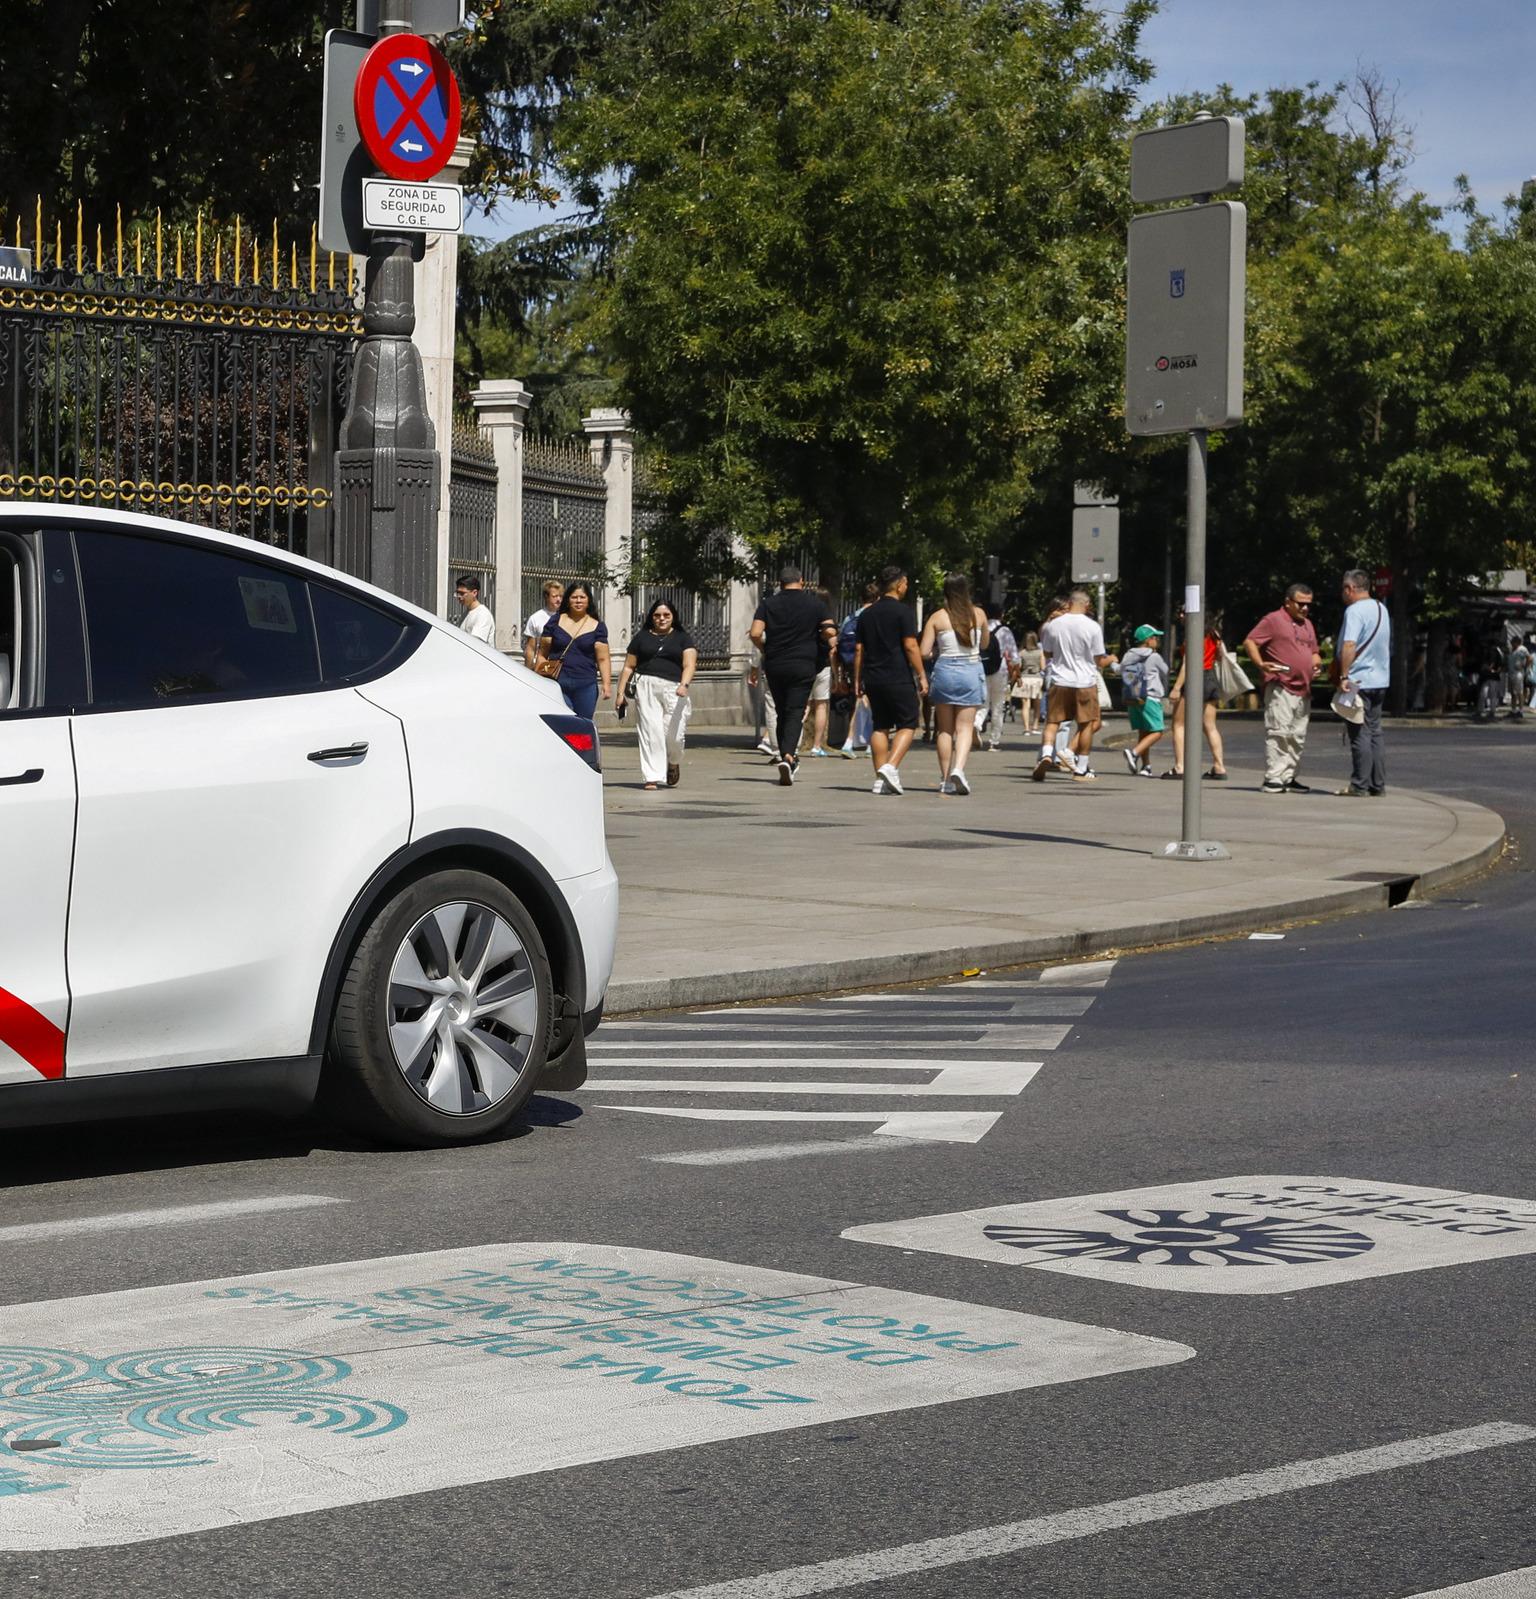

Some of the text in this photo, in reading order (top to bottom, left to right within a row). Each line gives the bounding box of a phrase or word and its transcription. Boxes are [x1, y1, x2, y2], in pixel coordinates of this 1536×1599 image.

[380, 200, 446, 214] SEGURIDAD
[388, 188, 438, 201] ZONA DE
[397, 215, 430, 226] C.G.E.
[1170, 359, 1197, 370] MOSA
[1211, 1192, 1527, 1236] Distrito
[373, 1287, 798, 1372] EMISIONES
[440, 1270, 931, 1366] DE ESPECIAL
[202, 1287, 816, 1410] ZONA DE BAJAS
